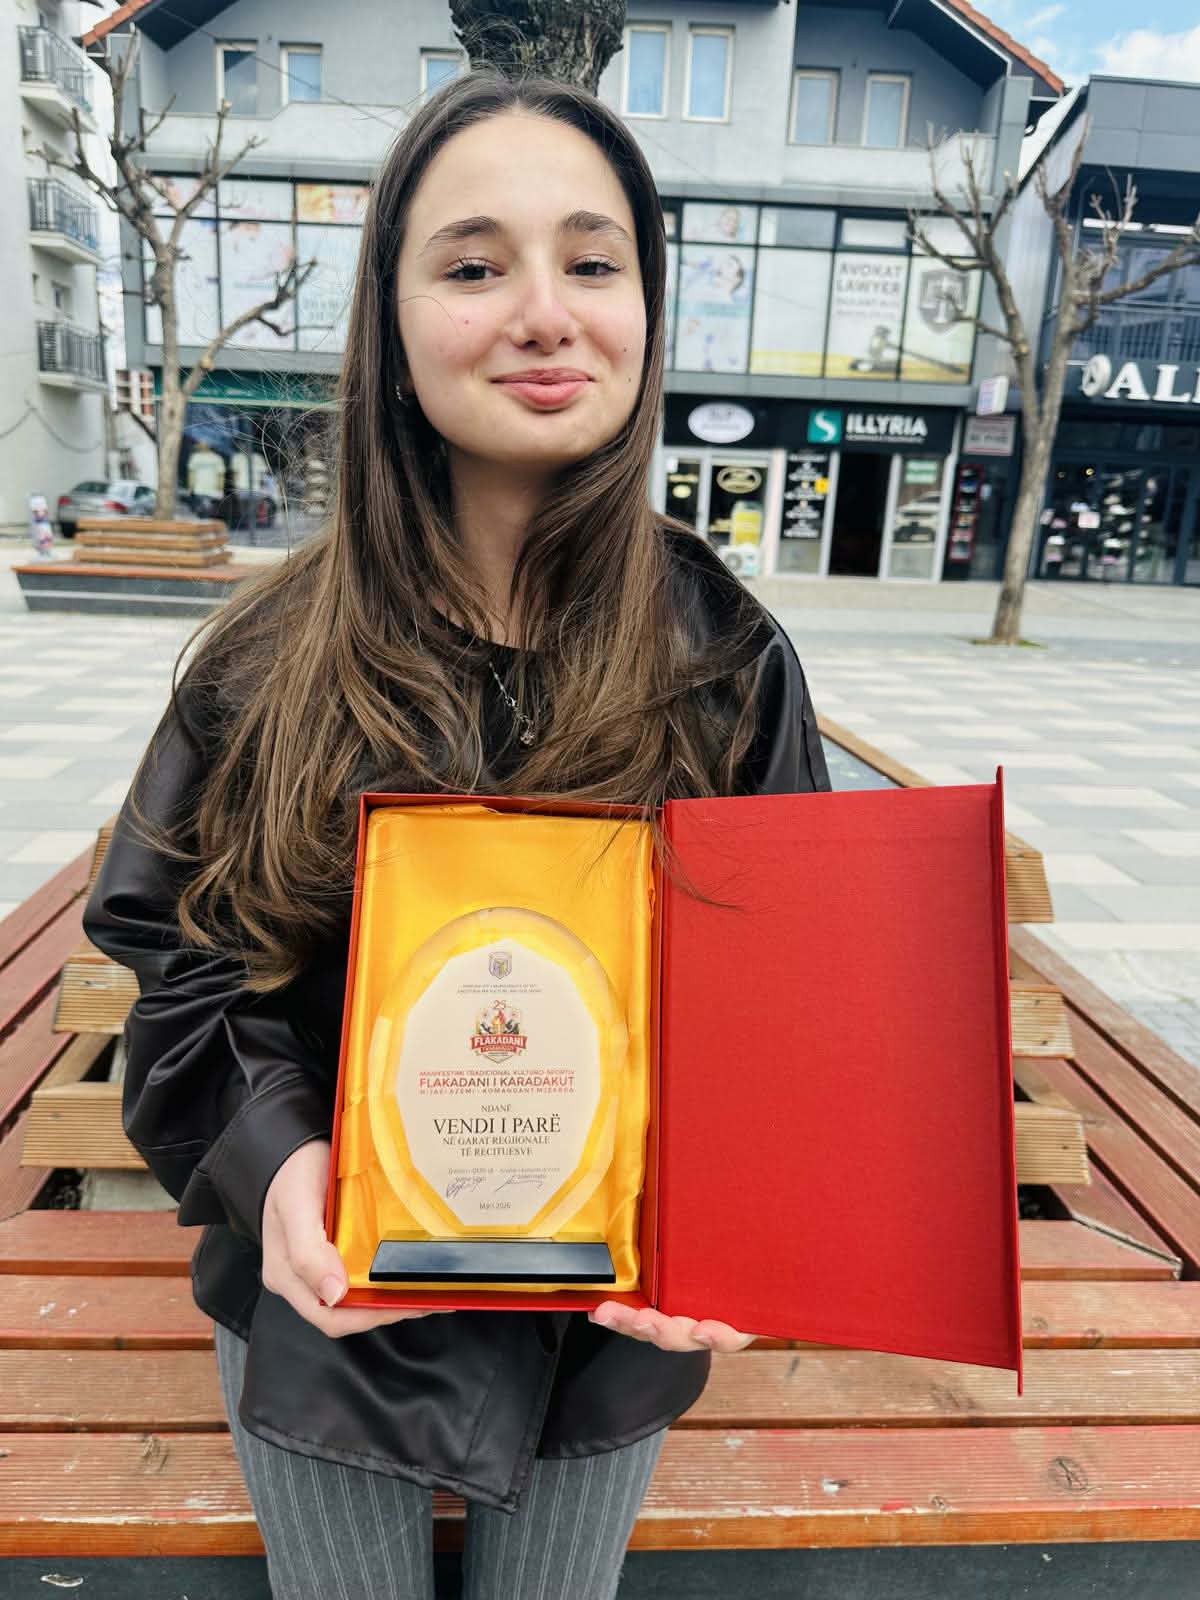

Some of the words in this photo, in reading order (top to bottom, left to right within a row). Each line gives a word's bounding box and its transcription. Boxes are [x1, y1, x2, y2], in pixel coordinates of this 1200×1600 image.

[837, 280, 900, 294] LAWYER
[846, 413, 928, 436] ILLYRIA
[474, 1036, 524, 1047] FLAKADANI
[419, 1077, 489, 1088] FLAKADANI
[500, 1076, 575, 1087] KARADAKUT
[433, 1118, 495, 1134] VENDI
[501, 1117, 506, 1133] I
[512, 1113, 561, 1133] PARË
[458, 1136, 490, 1145] GARAT
[474, 1146, 532, 1156] RECITUESVE
